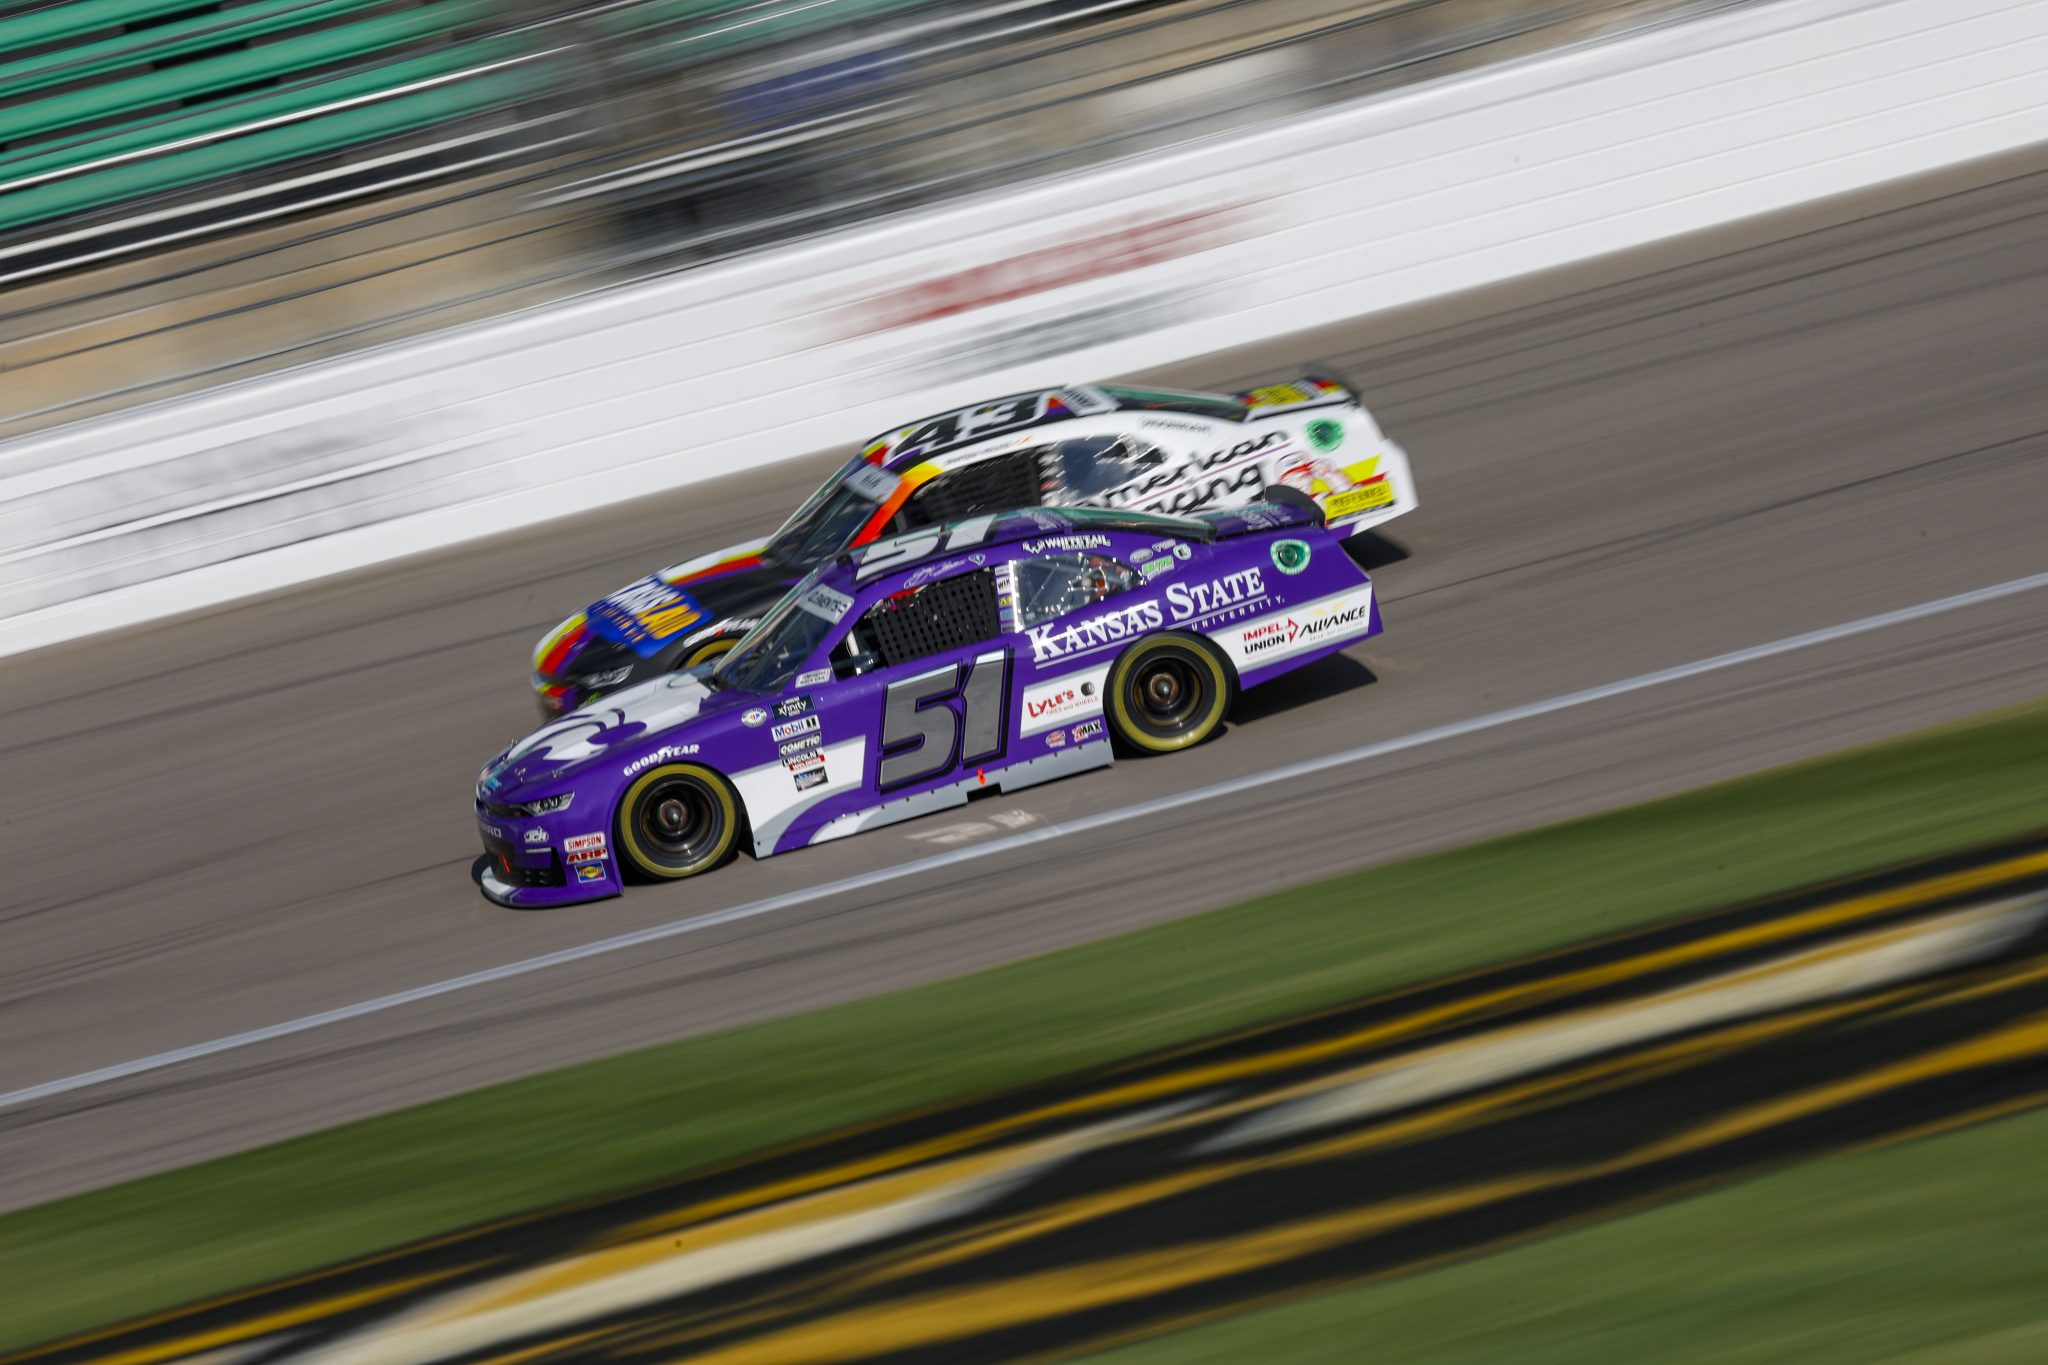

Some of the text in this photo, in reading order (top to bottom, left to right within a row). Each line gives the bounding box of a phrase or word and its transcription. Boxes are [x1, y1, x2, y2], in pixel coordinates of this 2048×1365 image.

[893, 396, 1048, 457] 43
[1025, 566, 1265, 663] KANSAS STATE
[1243, 622, 1280, 642] IMPEL
[1244, 634, 1285, 654] UNION
[774, 721, 804, 738] Mobil
[876, 645, 1013, 794] 51
[623, 744, 700, 777] GOODYEAR
[783, 750, 818, 767] LINCOLN
[567, 836, 602, 851] SIMPSON
[568, 848, 607, 862] ARP
